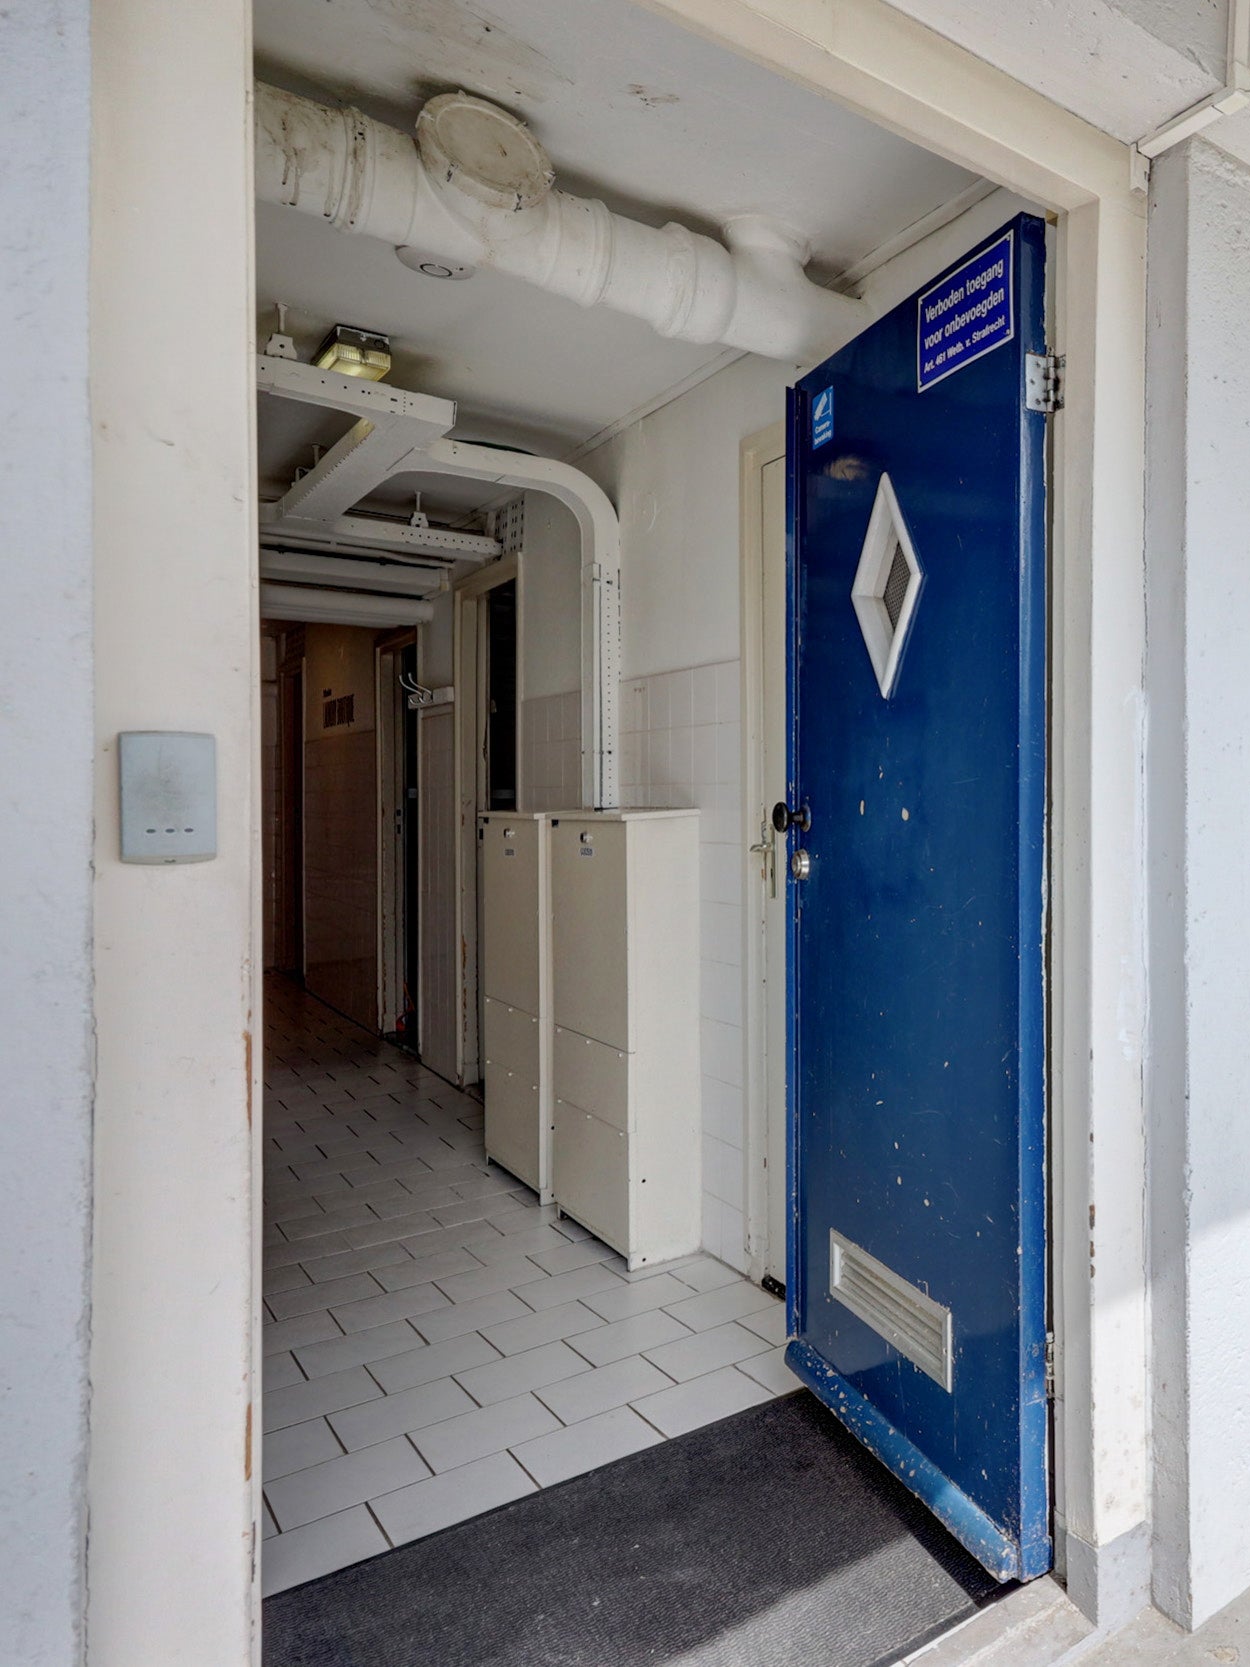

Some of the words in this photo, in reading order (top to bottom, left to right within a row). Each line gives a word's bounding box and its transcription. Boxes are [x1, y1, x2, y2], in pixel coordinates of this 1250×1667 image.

[924, 327, 943, 350] voor
[944, 287, 1005, 338] onbevoegden
[925, 287, 964, 323] Verboden
[966, 259, 1004, 295] toegang
[972, 315, 1005, 343] Strafrecht
